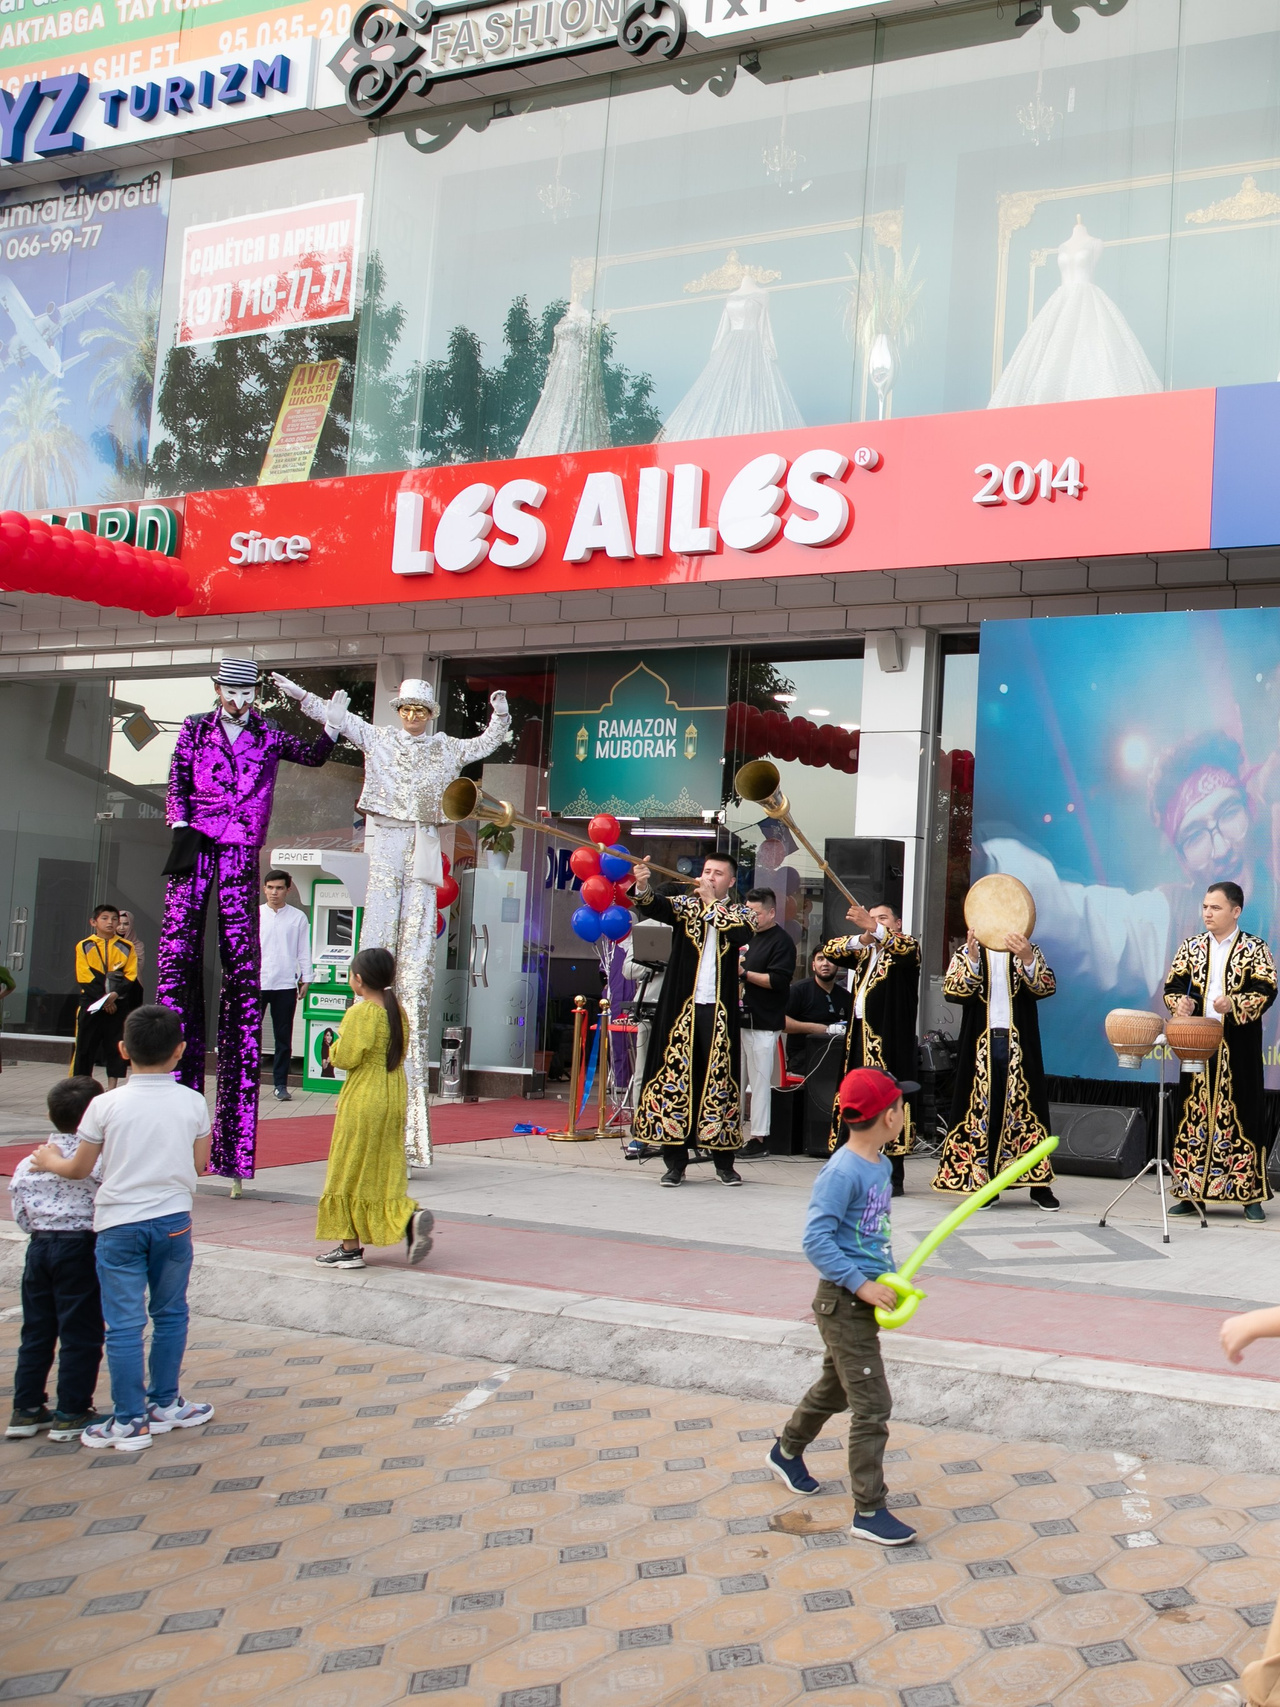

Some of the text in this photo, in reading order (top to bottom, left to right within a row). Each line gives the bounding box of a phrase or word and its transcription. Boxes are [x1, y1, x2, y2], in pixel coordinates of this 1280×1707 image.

[431, 0, 624, 65] FASHION
[99, 54, 291, 128] TURIZM
[64, 171, 161, 222] ziyorati
[6, 224, 103, 260] 066-99-77
[189, 219, 351, 277] СДАЁТСЯ В АРЕНДУ
[237, 261, 348, 320] 718-77-77
[294, 362, 340, 386] AVTO
[288, 393, 329, 407] ШКОЛА
[972, 456, 1086, 507] 2014
[391, 479, 547, 576] LES
[562, 448, 854, 563] AILES
[228, 530, 312, 566] Since
[598, 718, 678, 739] RAMAZON
[595, 740, 677, 759] MUBORAK
[278, 852, 315, 862] PAYNET
[320, 997, 346, 1005] PAYNET
